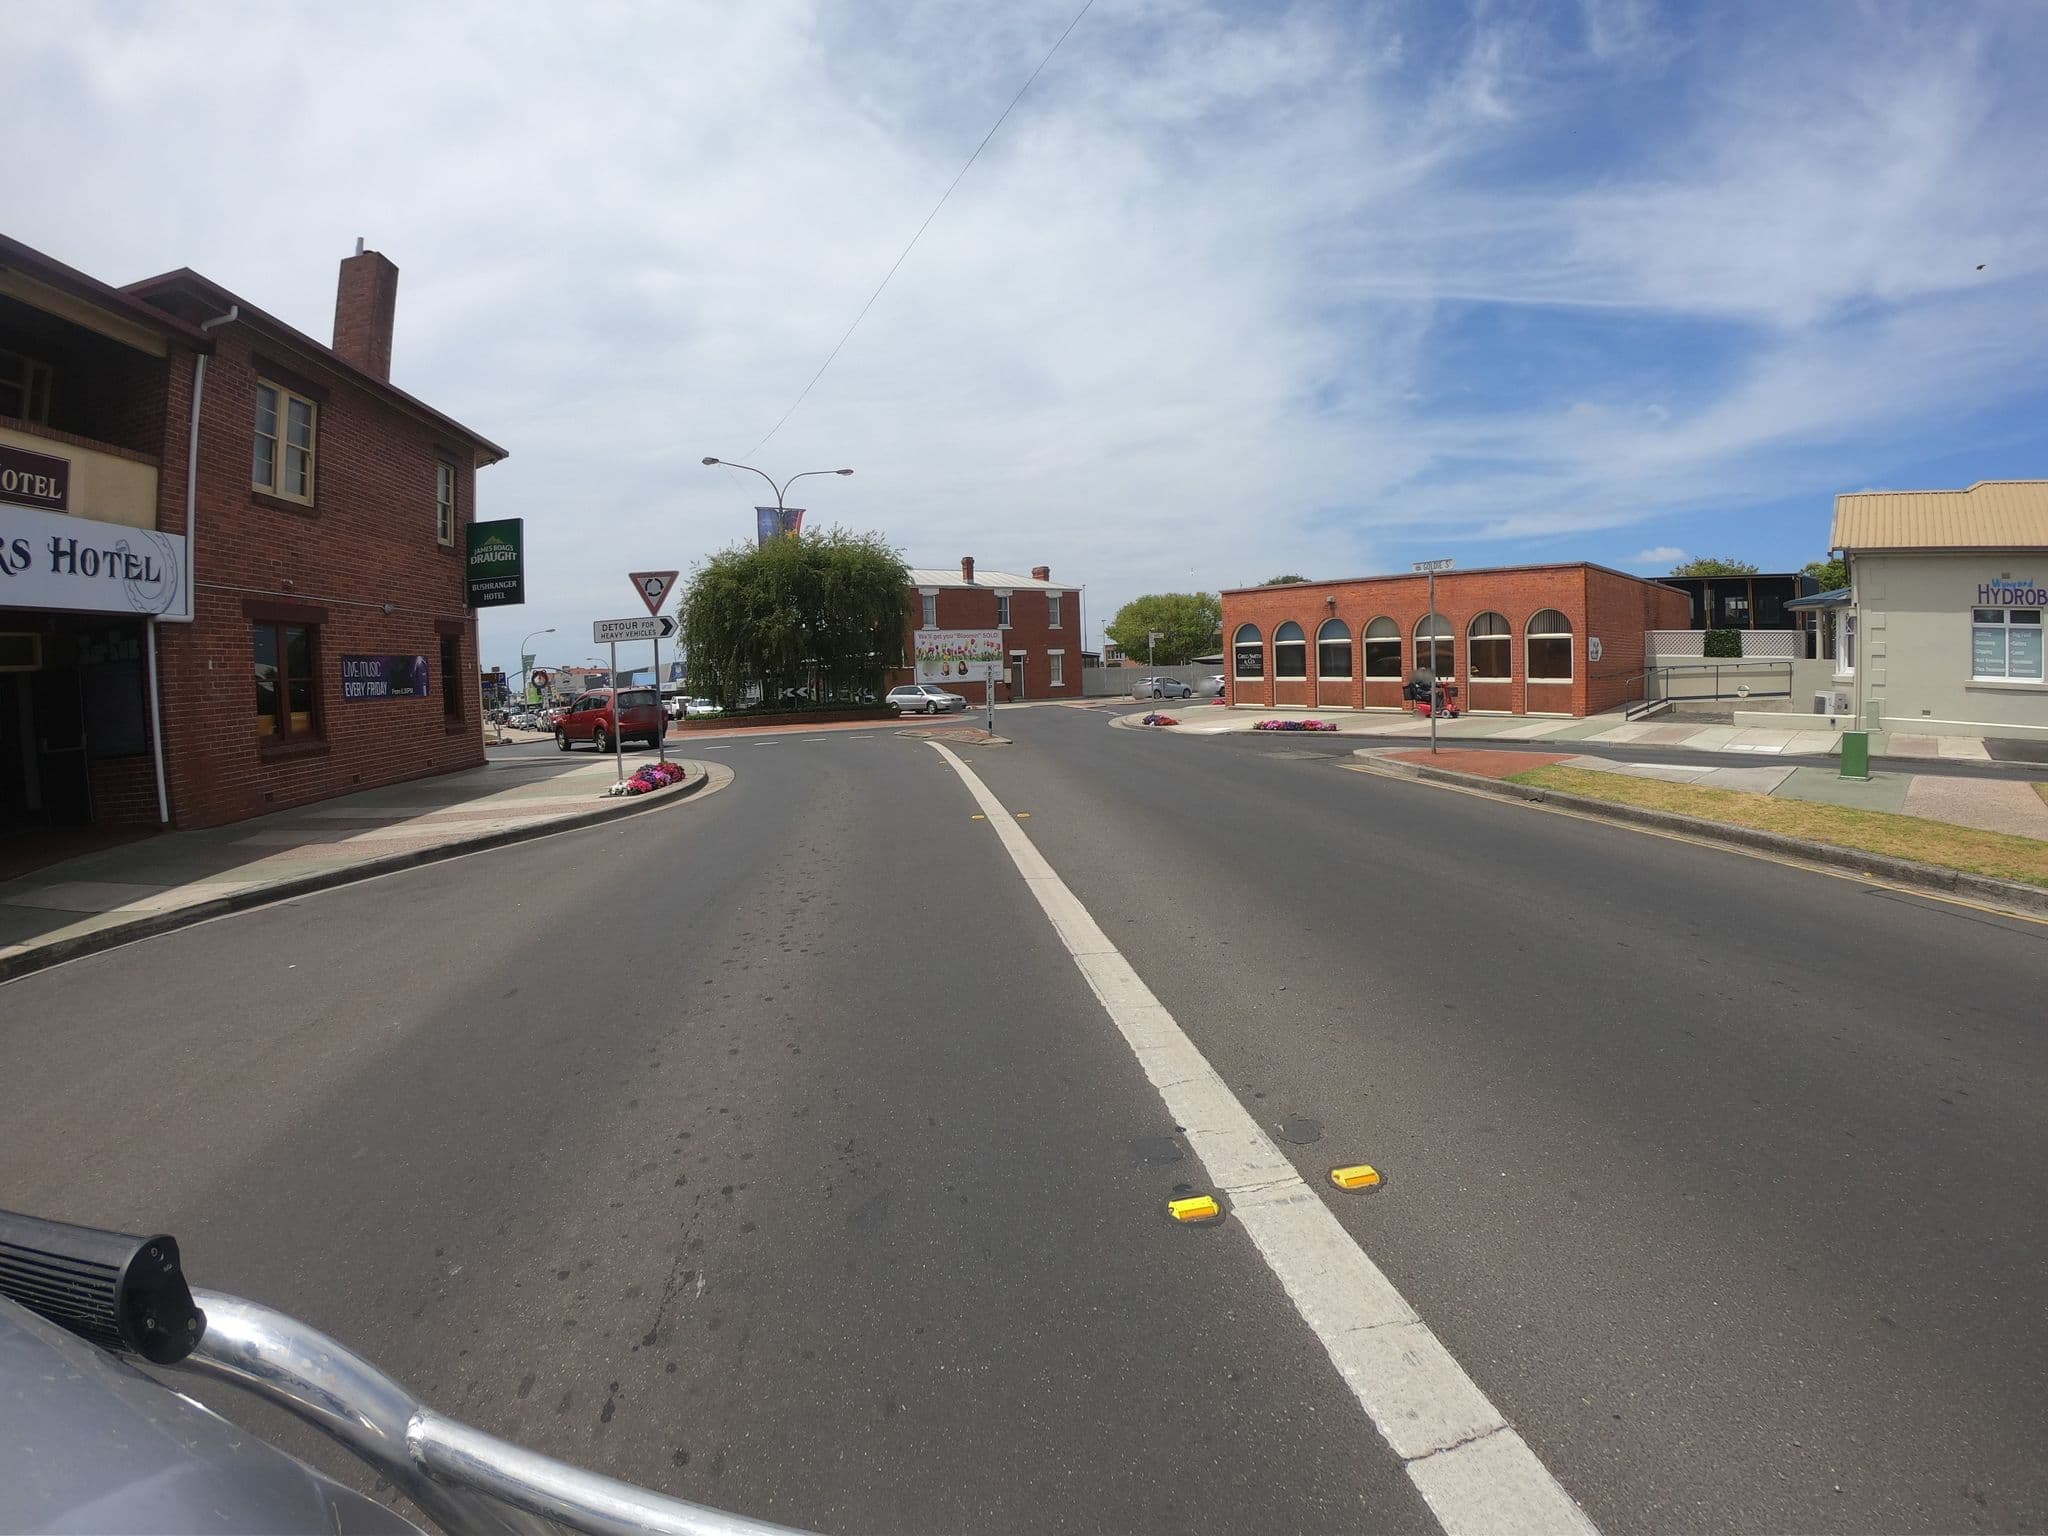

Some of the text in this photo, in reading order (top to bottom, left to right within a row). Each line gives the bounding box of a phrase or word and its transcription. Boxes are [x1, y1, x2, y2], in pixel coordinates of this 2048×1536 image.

[0, 468, 62, 499] OTEL
[474, 545, 493, 555] JAMES
[470, 551, 518, 565] DRAUGHT
[472, 580, 517, 591] BUSHRANGER
[483, 592, 506, 600] HOTEL
[602, 621, 638, 632] DETOUR
[601, 629, 657, 640] HEAVY VEHICLES
[343, 661, 381, 677] LIVE MUSIC
[345, 681, 388, 696] EVERY FRIDAY
